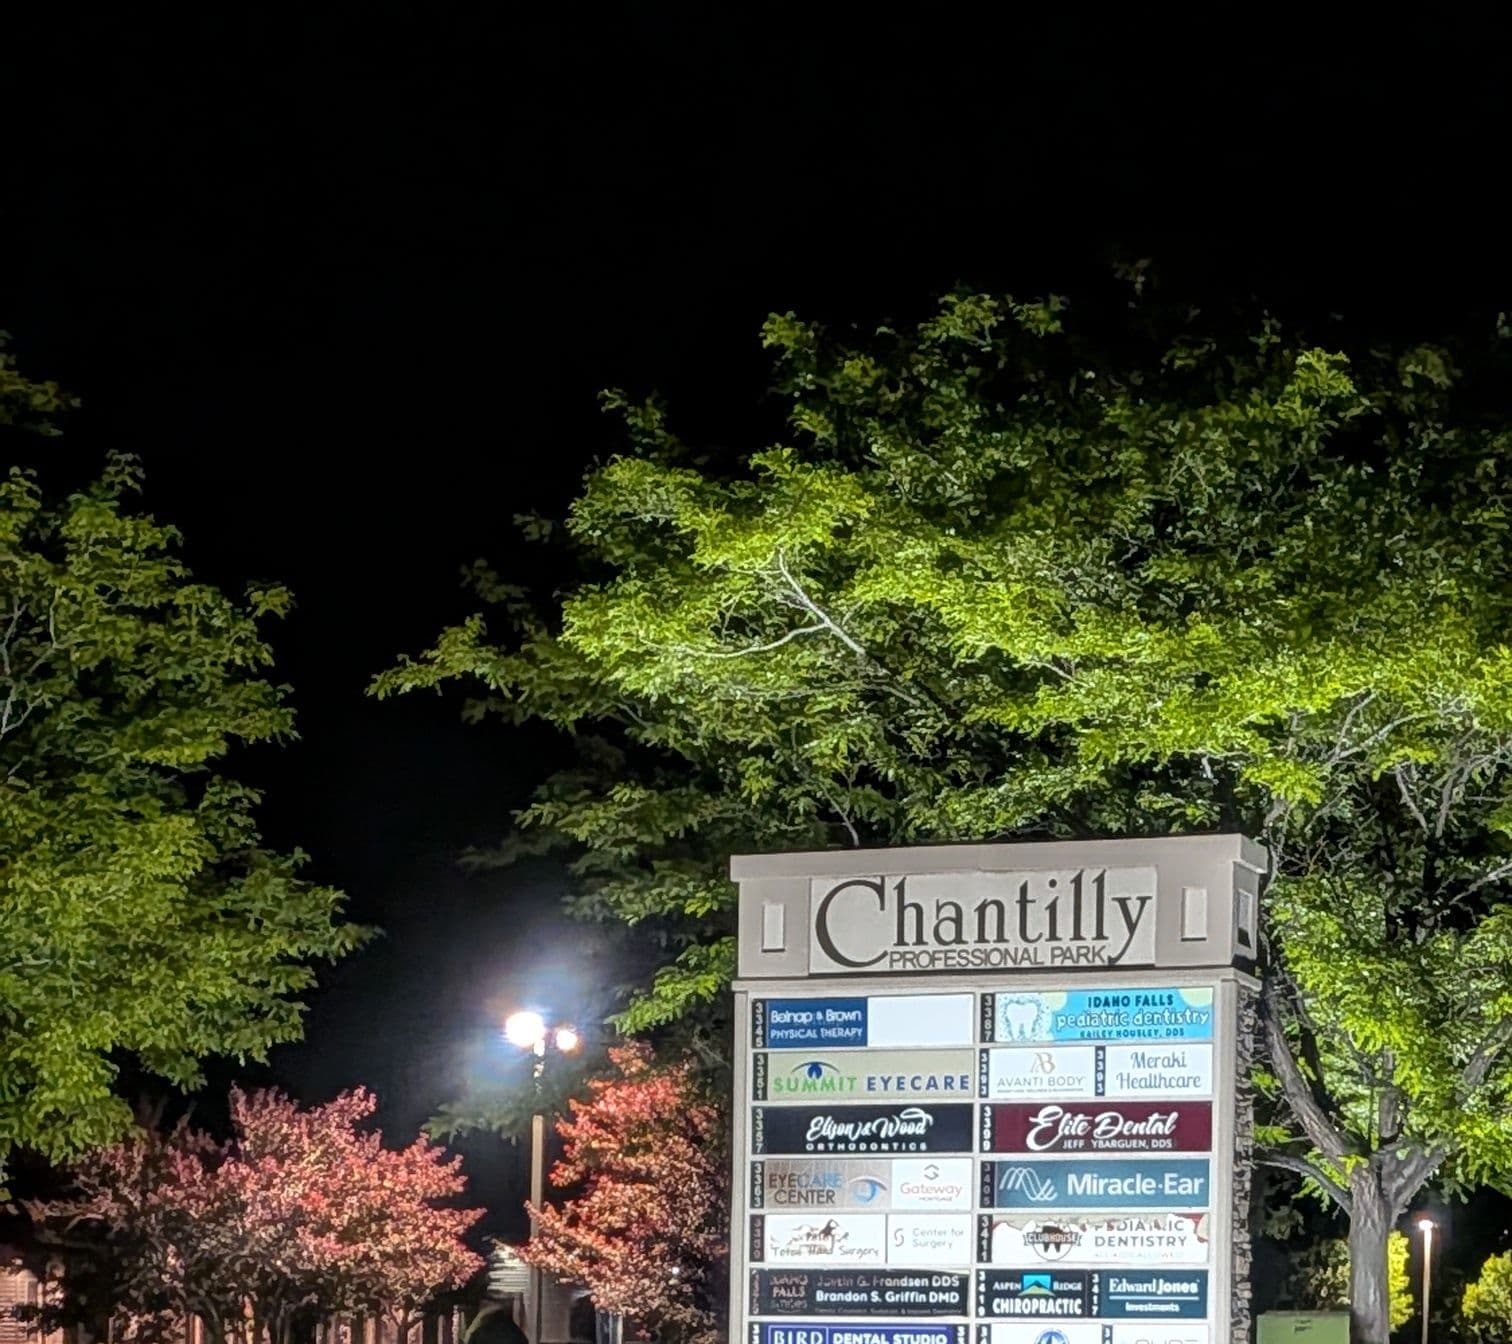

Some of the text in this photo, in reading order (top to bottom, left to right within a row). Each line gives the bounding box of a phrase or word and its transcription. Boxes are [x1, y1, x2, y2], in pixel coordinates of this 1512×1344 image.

[815, 867, 1153, 968] Chantilly
[888, 945, 1105, 968] PROFESSIONAL PARK
[1088, 994, 1174, 1008] IDAHO FALLS
[825, 1009, 862, 1022] Brown
[984, 994, 993, 1041] 3387
[1056, 1006, 1209, 1029] pediatric dentistry
[770, 1028, 863, 1039] PHYSICAL THERAPY
[1165, 1028, 1185, 1037] DDS
[1130, 1051, 1188, 1069] Meraki
[772, 1075, 970, 1092] SUMMIT EYECARE
[997, 1076, 1084, 1087] AVANTI BODY
[1116, 1073, 1201, 1091] Healthcare
[872, 1107, 934, 1139] Wood
[983, 1106, 992, 1151] 3399
[1026, 1105, 1179, 1151] Elite Dental
[806, 1142, 927, 1151] ORTHODONTICS
[1062, 1139, 1172, 1149] JEFF YBARGUEN, DDS
[768, 1173, 842, 1189] EYECARE
[983, 1163, 991, 1206] 3405
[775, 1189, 836, 1205] CENTER
[900, 1182, 962, 1197] Gateway
[912, 1227, 965, 1237] Center for
[981, 1216, 989, 1262] 3411
[1027, 1233, 1078, 1243] CLUBHOUSE
[912, 1239, 953, 1249] Surgery
[1094, 1236, 1188, 1248] DENTISTRY
[932, 1274, 960, 1287] DDS
[1109, 1278, 1199, 1295] Edward Jones
[816, 1291, 959, 1303] Brandon S. Griffin DMD
[992, 1297, 1082, 1315] CHIROPRACTIC
[1125, 1302, 1180, 1313] Investments
